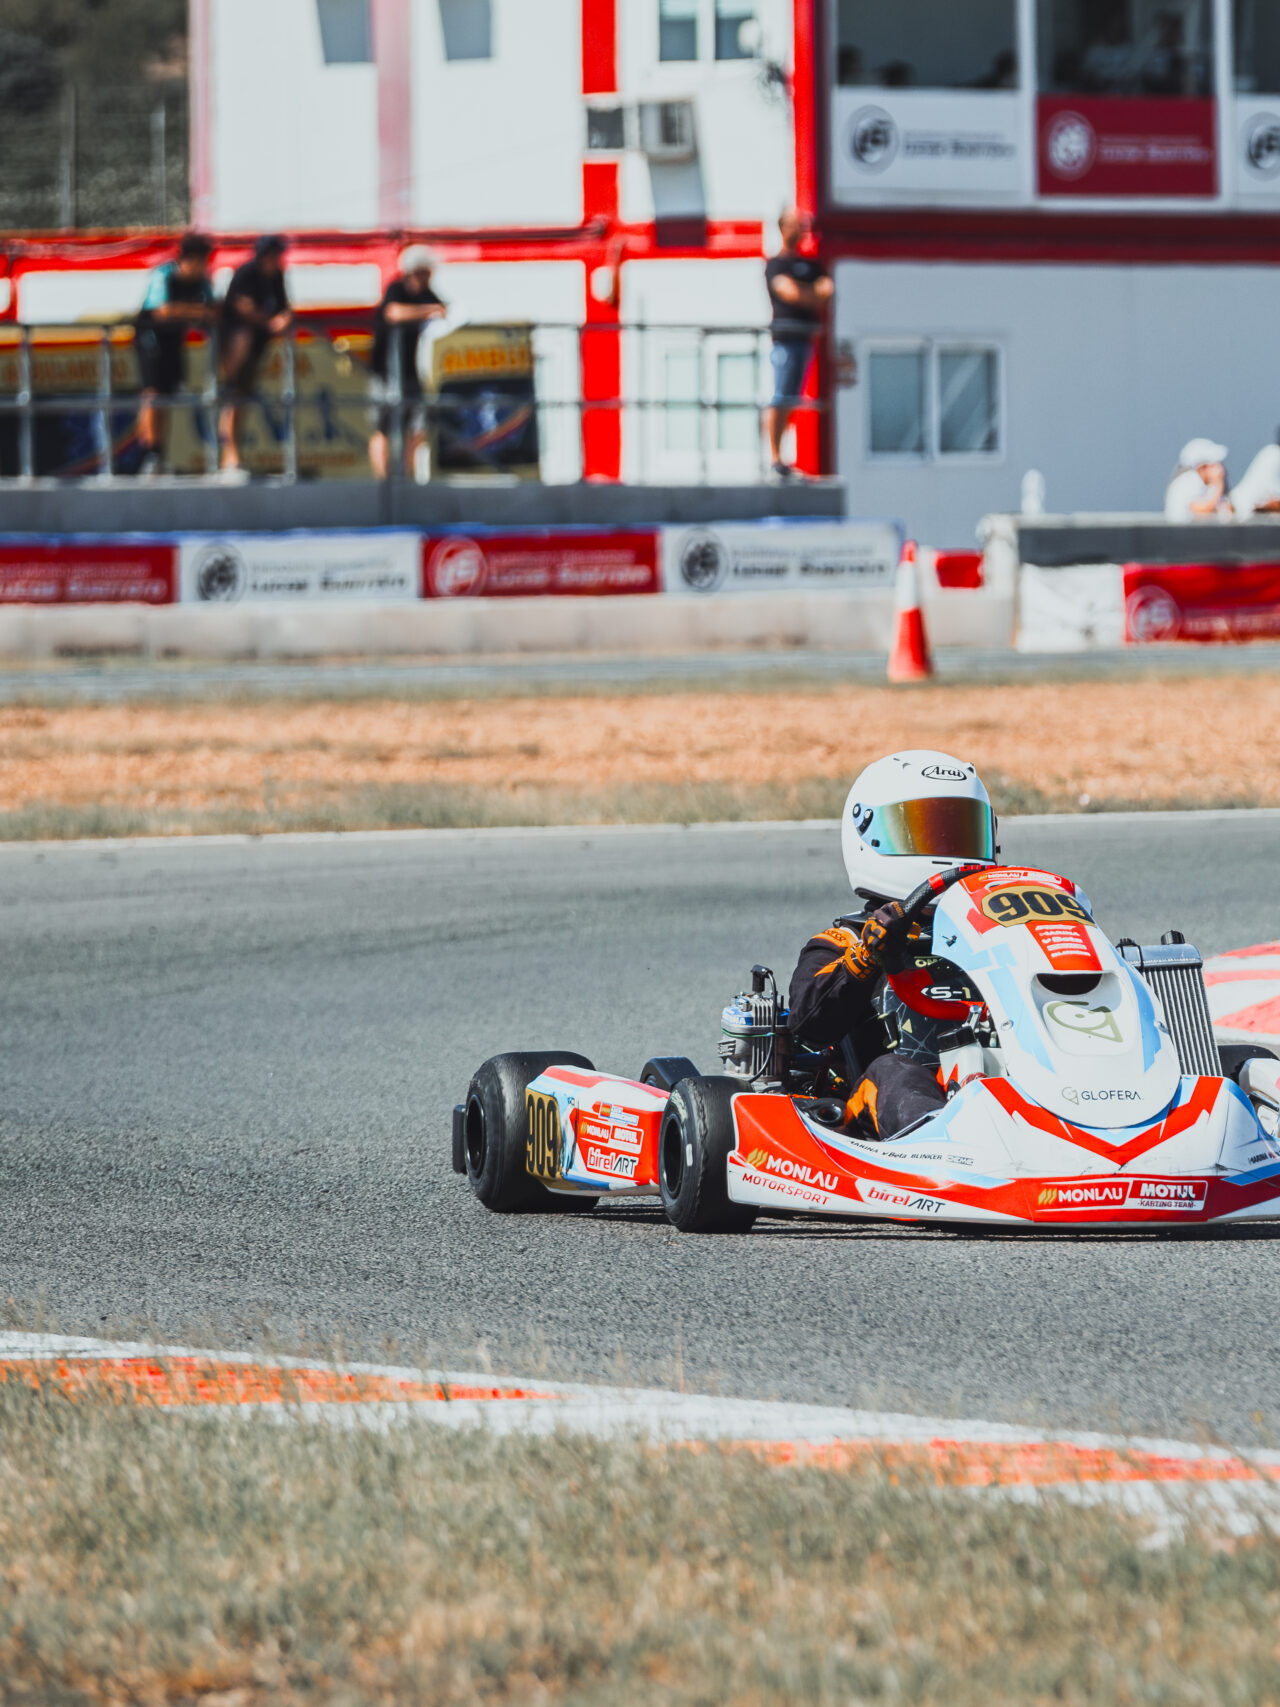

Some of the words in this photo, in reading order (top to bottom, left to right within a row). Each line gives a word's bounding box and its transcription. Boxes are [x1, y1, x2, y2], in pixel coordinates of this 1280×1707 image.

[930, 765, 962, 778] Arai
[987, 890, 1096, 925] 909
[1081, 1090, 1142, 1101] GLOFERA
[527, 1093, 559, 1178] 909
[588, 1149, 637, 1176] birelART
[766, 1154, 839, 1191] MONLAU
[742, 1172, 831, 1206] MOTORSPORT
[868, 1186, 946, 1214] birelART
[1058, 1186, 1123, 1203] MONLAU
[1140, 1182, 1196, 1199] MOTUL
